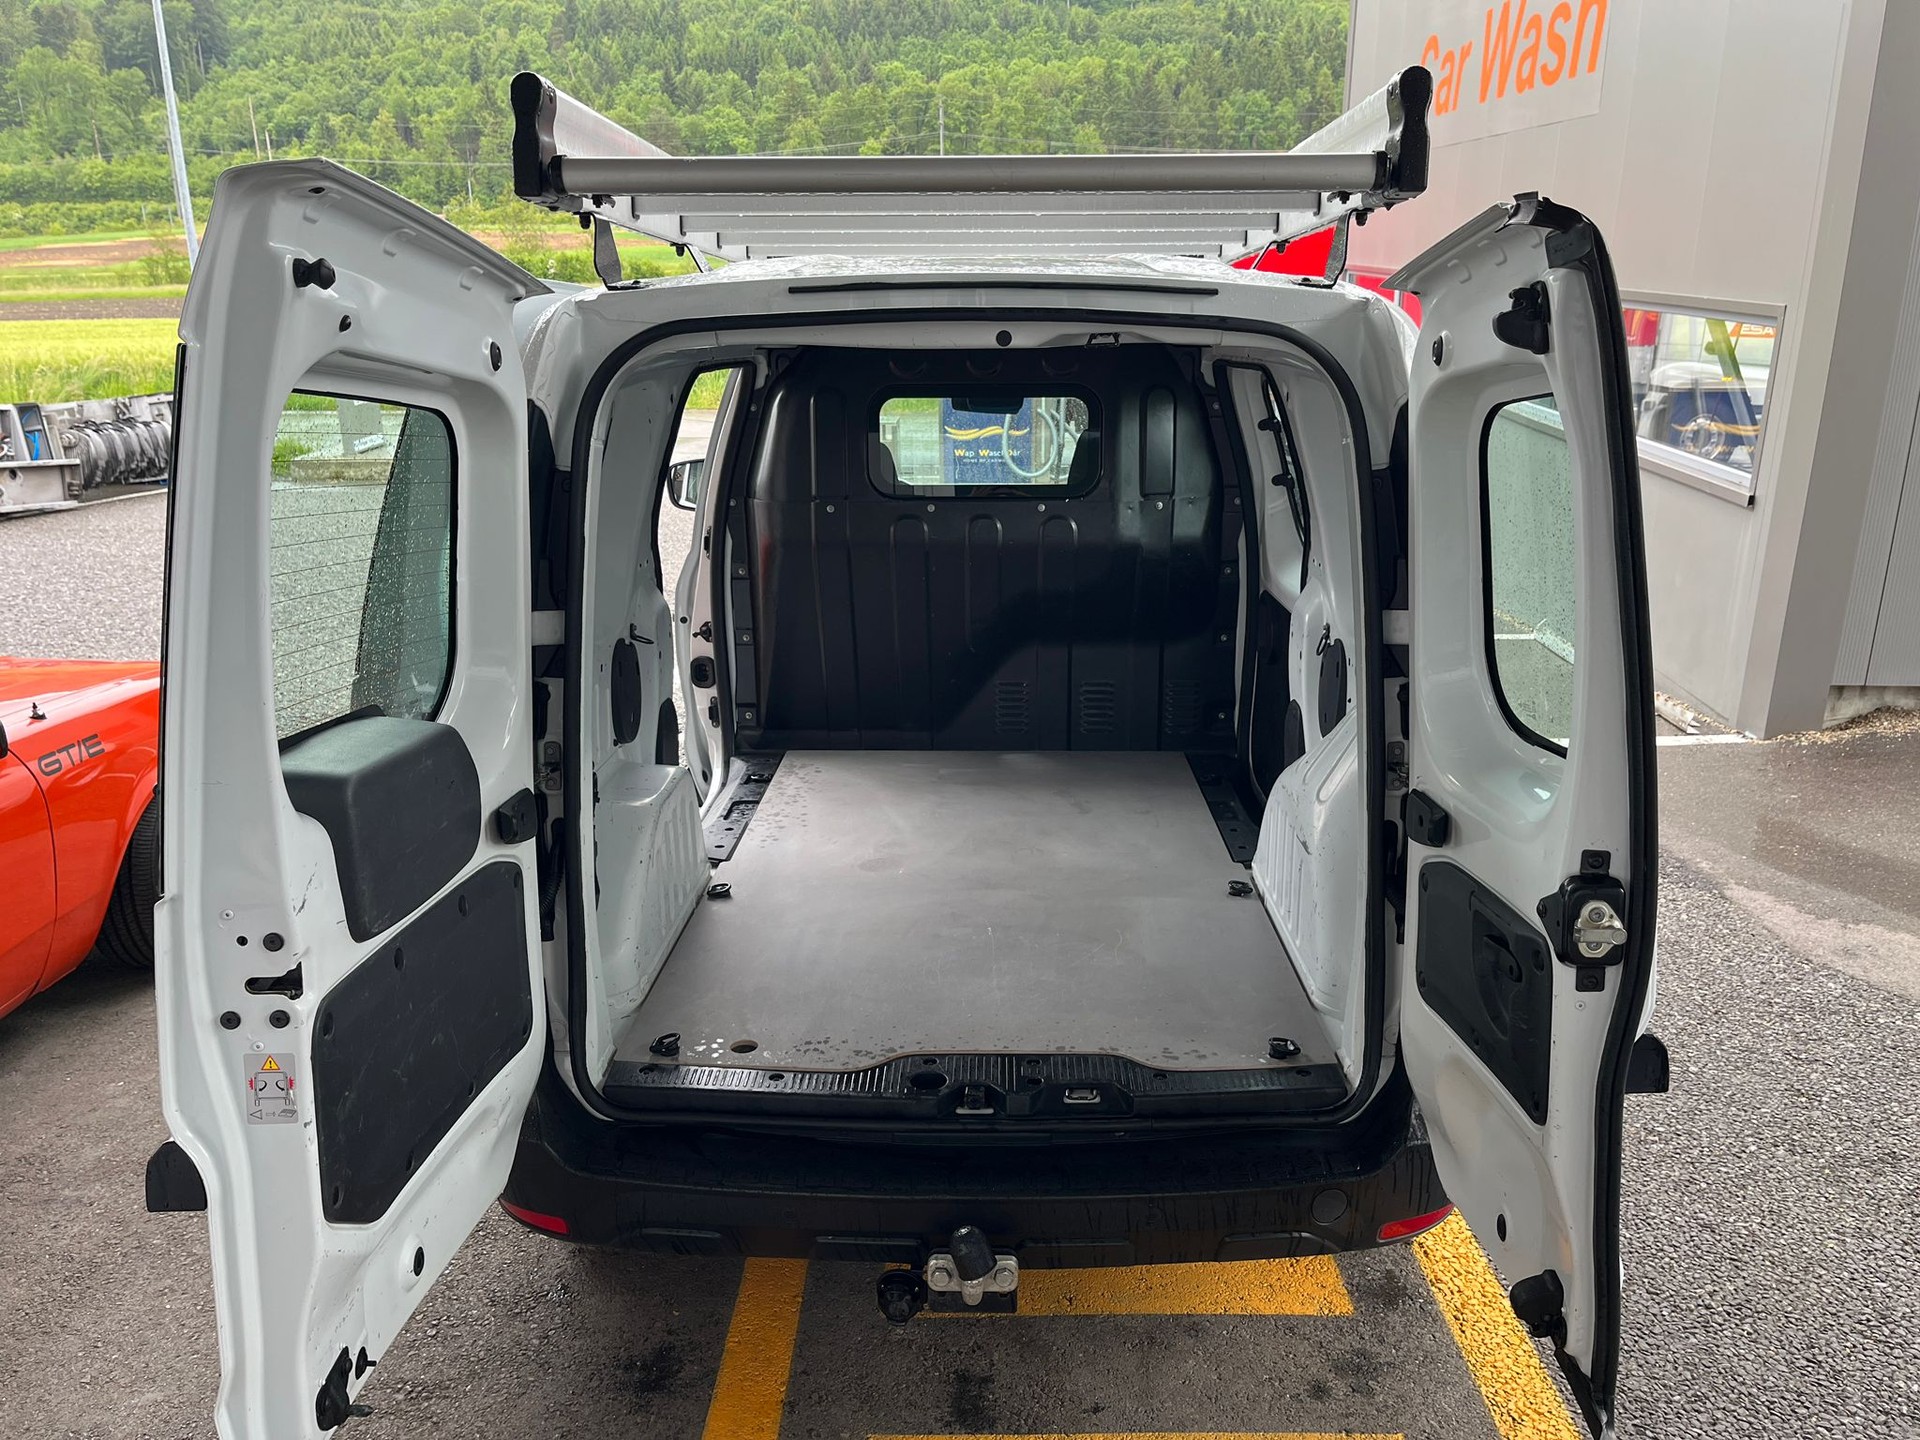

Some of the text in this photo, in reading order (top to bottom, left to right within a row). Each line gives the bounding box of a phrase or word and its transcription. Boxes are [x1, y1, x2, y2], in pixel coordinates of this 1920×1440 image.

[1479, 0, 1608, 104] Wash
[1740, 323, 1775, 335] ESA
[954, 449, 975, 457] Wap
[38, 733, 106, 777] GT/E
